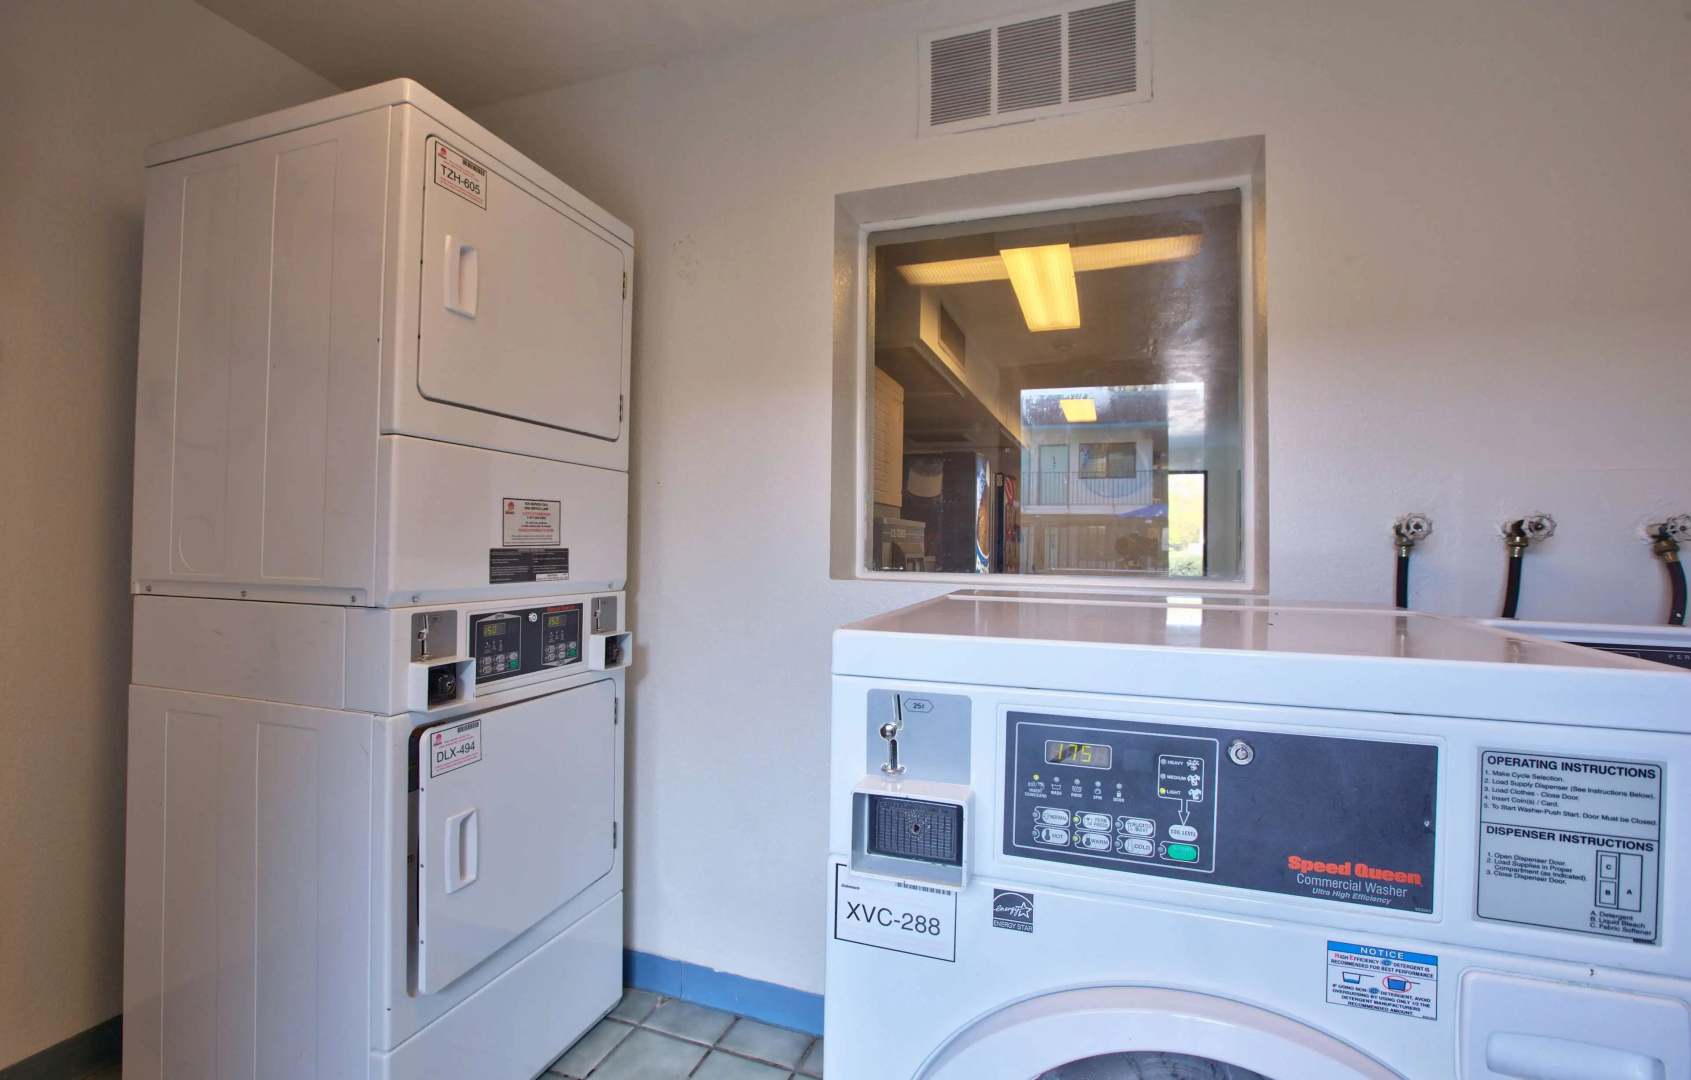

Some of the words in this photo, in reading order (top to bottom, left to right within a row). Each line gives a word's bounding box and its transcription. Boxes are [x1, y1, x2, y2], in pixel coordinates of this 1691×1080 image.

[440, 164, 480, 194] TZH-605
[437, 741, 475, 762] DLX-494
[1058, 743, 1092, 762] 175
[1487, 756, 1558, 770] OPERATING
[1561, 762, 1656, 779] INSTRUCTIONS
[1532, 774, 1564, 782] Selection.
[1535, 783, 1568, 791] Dispenser
[1588, 788, 1627, 796] Instructions
[1630, 792, 1656, 800] Below).
[1511, 797, 1535, 805] Coin(s)
[1518, 807, 1561, 816] Washer-Push
[1487, 826, 1555, 841] DISPENSER
[1559, 834, 1654, 852] INSTRUCTIONS
[1512, 861, 1540, 869] Supplies
[1514, 855, 1547, 864] Dispenser
[1288, 856, 1352, 876] Speed
[1354, 863, 1422, 884] Queen
[1494, 865, 1539, 875] Compartment
[1553, 872, 1588, 881] Indicated).
[1514, 873, 1547, 882] Dispenser
[1296, 873, 1362, 892] Commercial
[1365, 882, 1408, 898] Washer
[1312, 888, 1331, 896] Ultra
[1332, 891, 1350, 899] High
[1352, 893, 1392, 905] Efficiency
[846, 901, 941, 936] XVC-288
[1600, 912, 1633, 920] Detergent
[993, 920, 1016, 930] ENERGY
[1017, 923, 1033, 932] STAR
[1622, 927, 1652, 936] Softener
[1360, 947, 1404, 960] NOTICE
[1330, 959, 1369, 969] RECOMMENDED
[1396, 968, 1434, 978] PERFORMANCE
[1350, 955, 1379, 965] EFFICIENCY
[1393, 962, 1424, 971] DETERGENT
[1342, 995, 1373, 1004] DETERGENT
[1374, 1000, 1421, 1012] MANUFACTURERS
[1380, 991, 1414, 1000] DETERGENT,
[1348, 1001, 1389, 1012] RECOMMENDED
